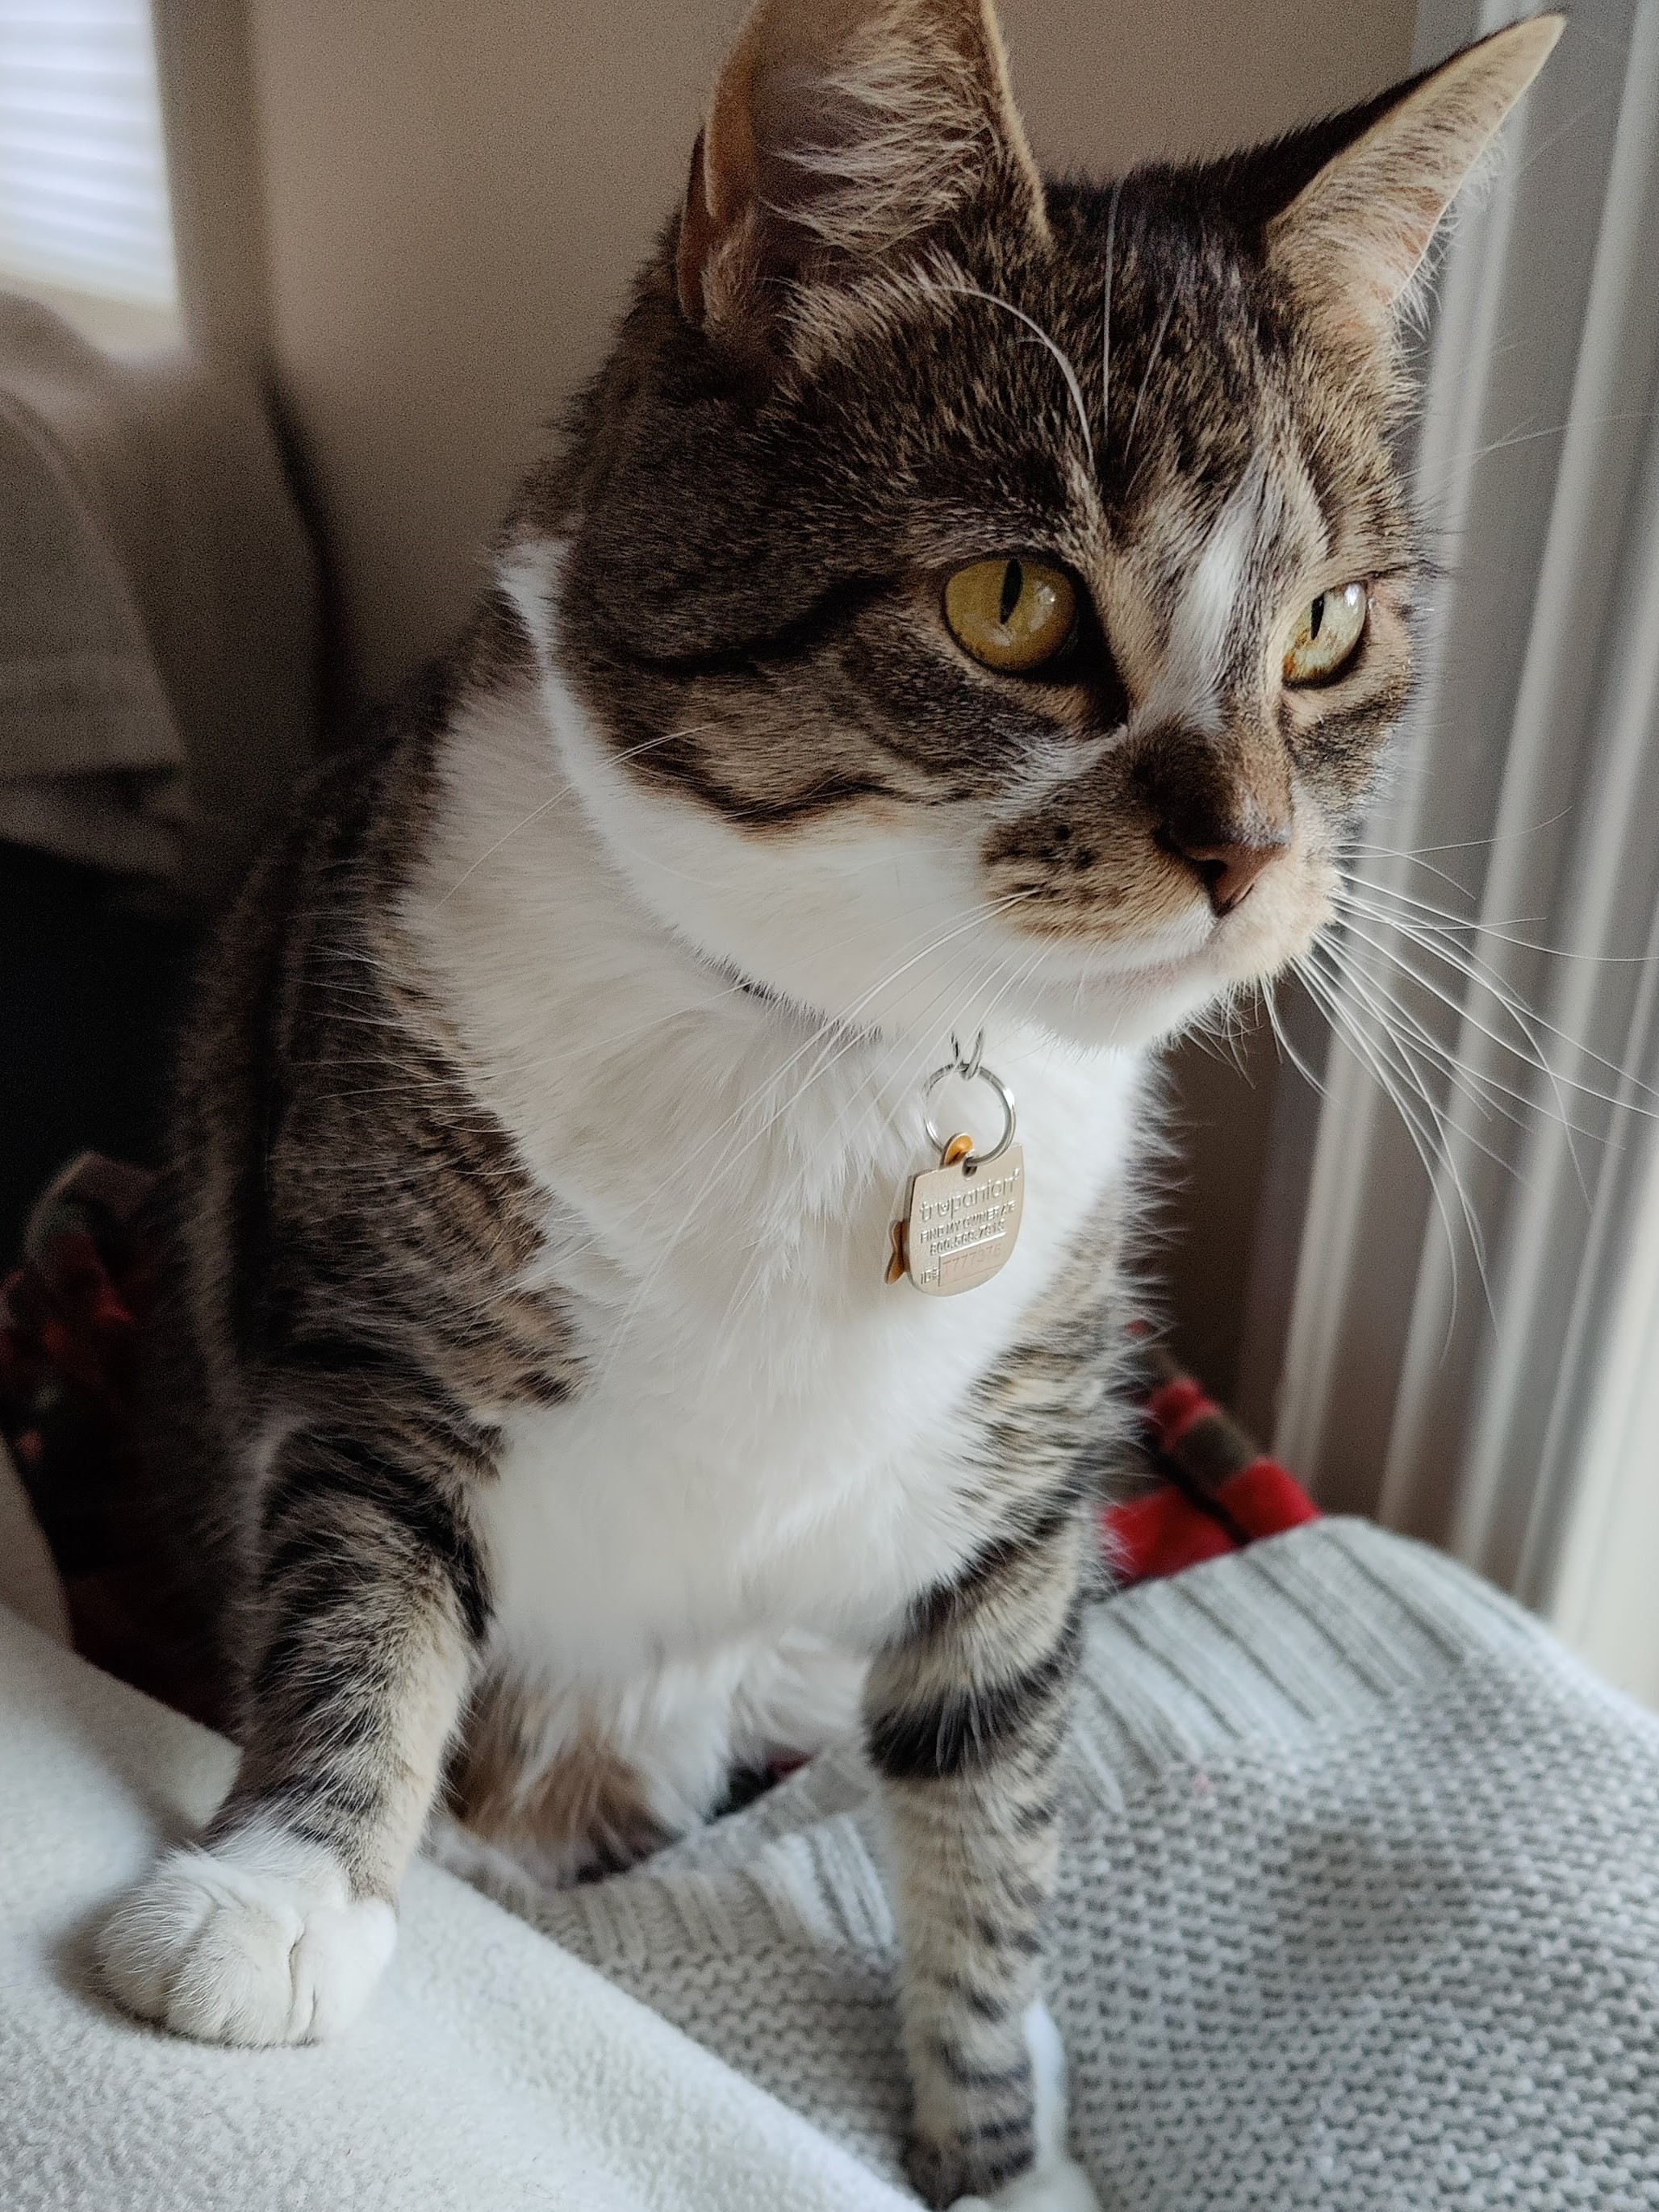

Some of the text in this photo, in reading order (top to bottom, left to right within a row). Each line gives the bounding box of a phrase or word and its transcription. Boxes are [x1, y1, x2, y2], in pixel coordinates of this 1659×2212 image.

[920, 1177, 1014, 1221] trupanion
[921, 1225, 944, 1243] FIND
[946, 1218, 961, 1235] MY
[963, 1206, 1000, 1229] OWNER
